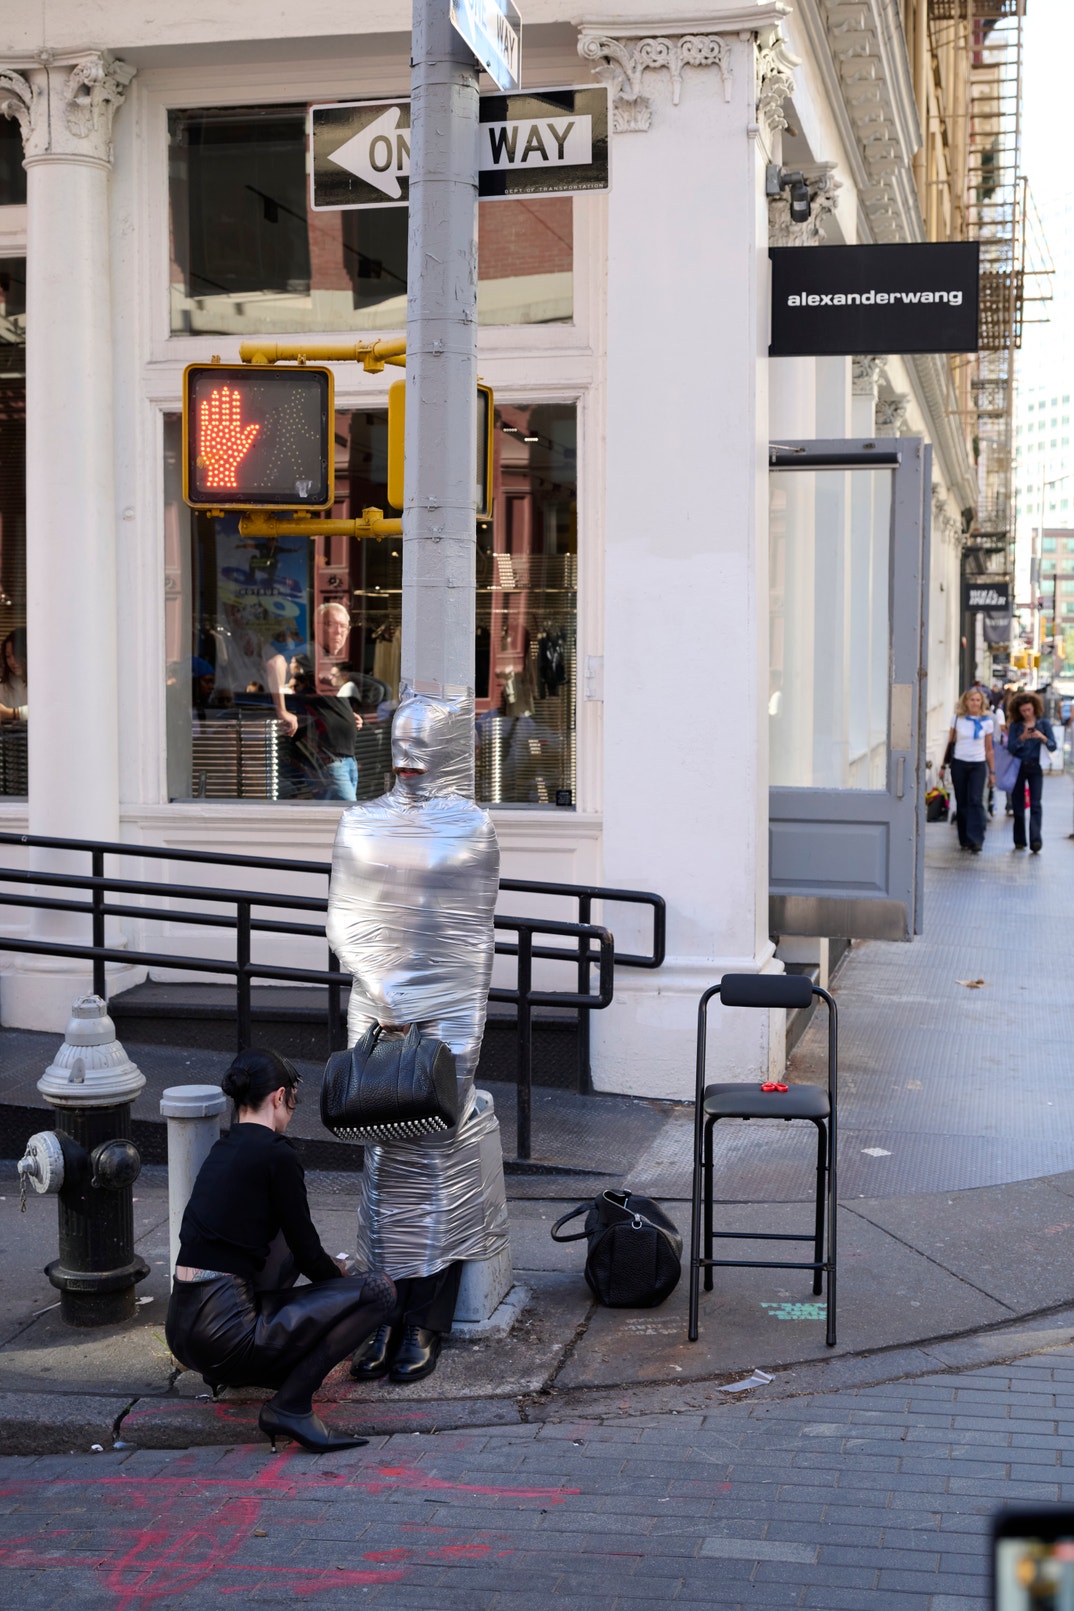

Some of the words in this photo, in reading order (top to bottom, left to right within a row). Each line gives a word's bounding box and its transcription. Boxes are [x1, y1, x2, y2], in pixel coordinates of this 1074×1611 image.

[497, 13, 516, 70] WAY
[369, 134, 410, 172] ON
[488, 121, 576, 164] WAY
[539, 183, 604, 192] TRANSPORTATION
[787, 290, 963, 306] alexanderwang
